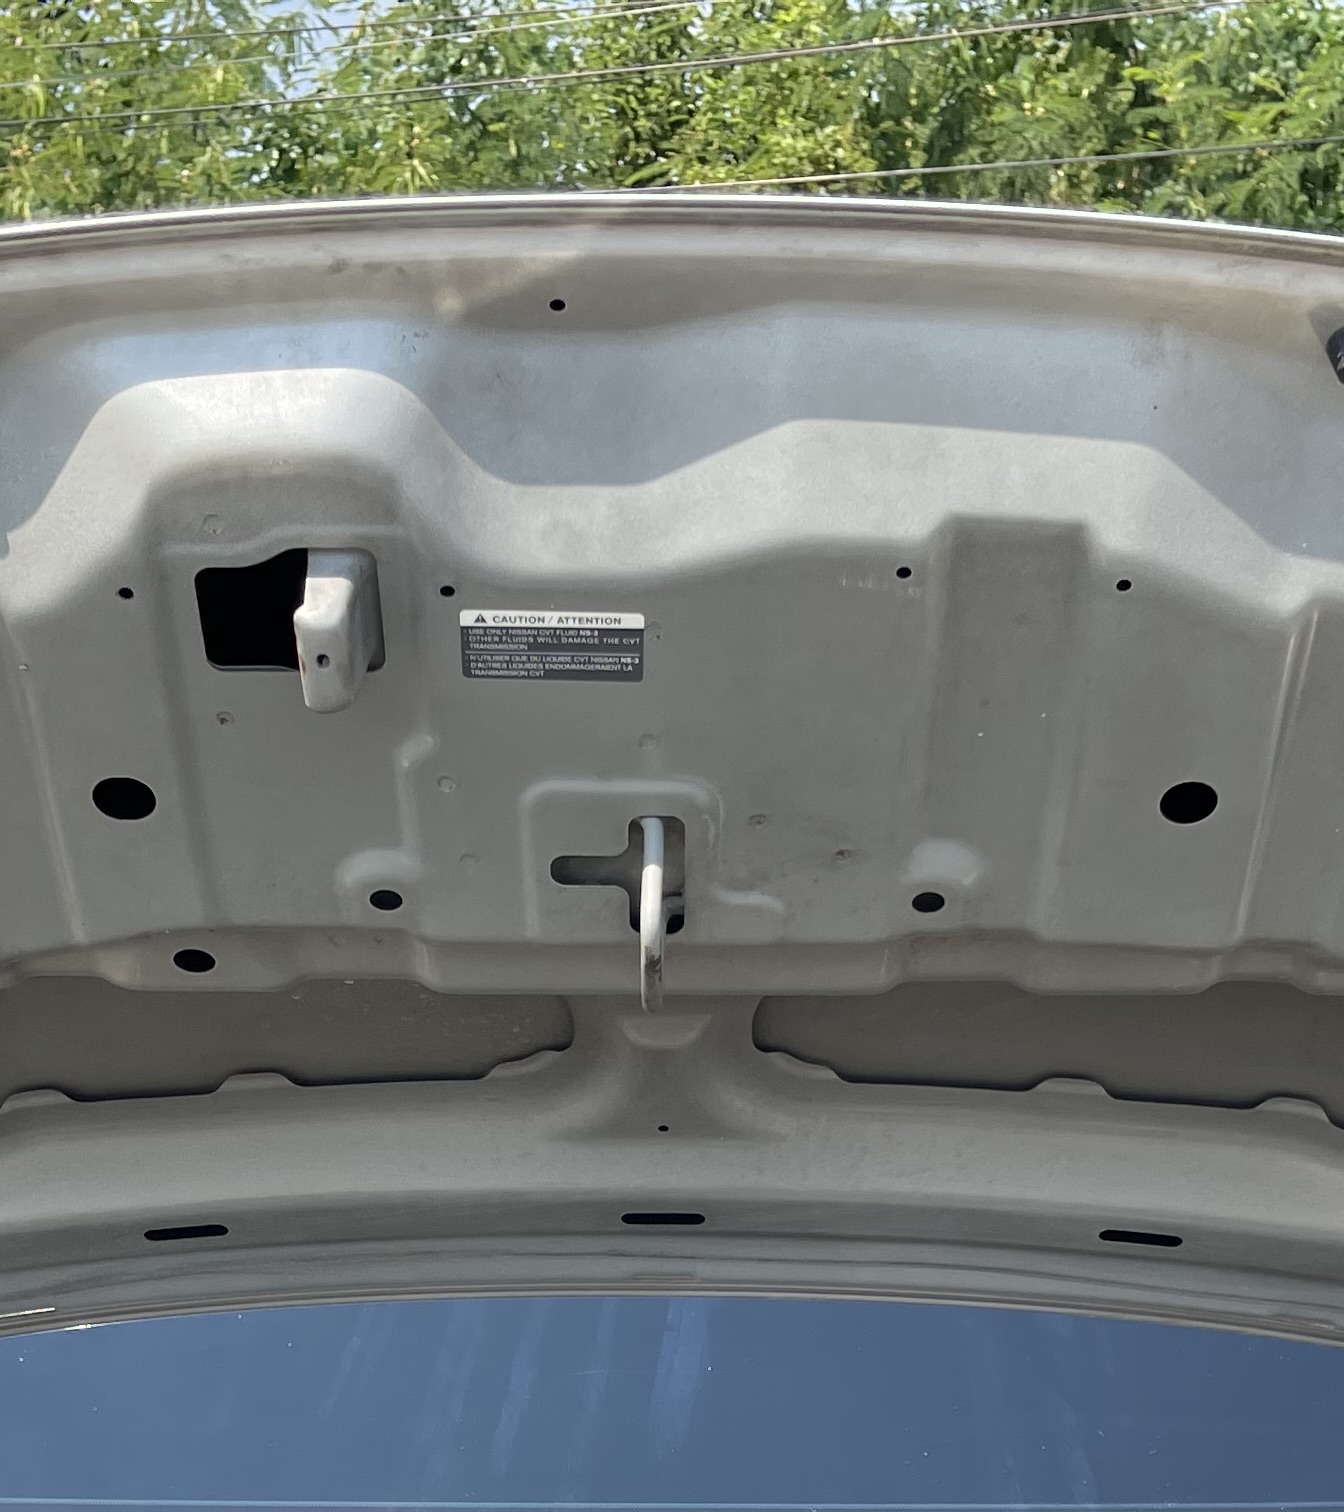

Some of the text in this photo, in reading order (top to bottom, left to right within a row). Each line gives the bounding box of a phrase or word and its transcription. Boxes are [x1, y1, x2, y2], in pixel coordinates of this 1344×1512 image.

[492, 615, 546, 624] CAUTION
[557, 616, 622, 625] ATTENTION
[502, 636, 534, 644] FLUIDS
[536, 636, 559, 644] WILL
[561, 637, 600, 645] DAMAGE
[603, 637, 620, 645] THE
[469, 643, 528, 651] TRANSMISSION
